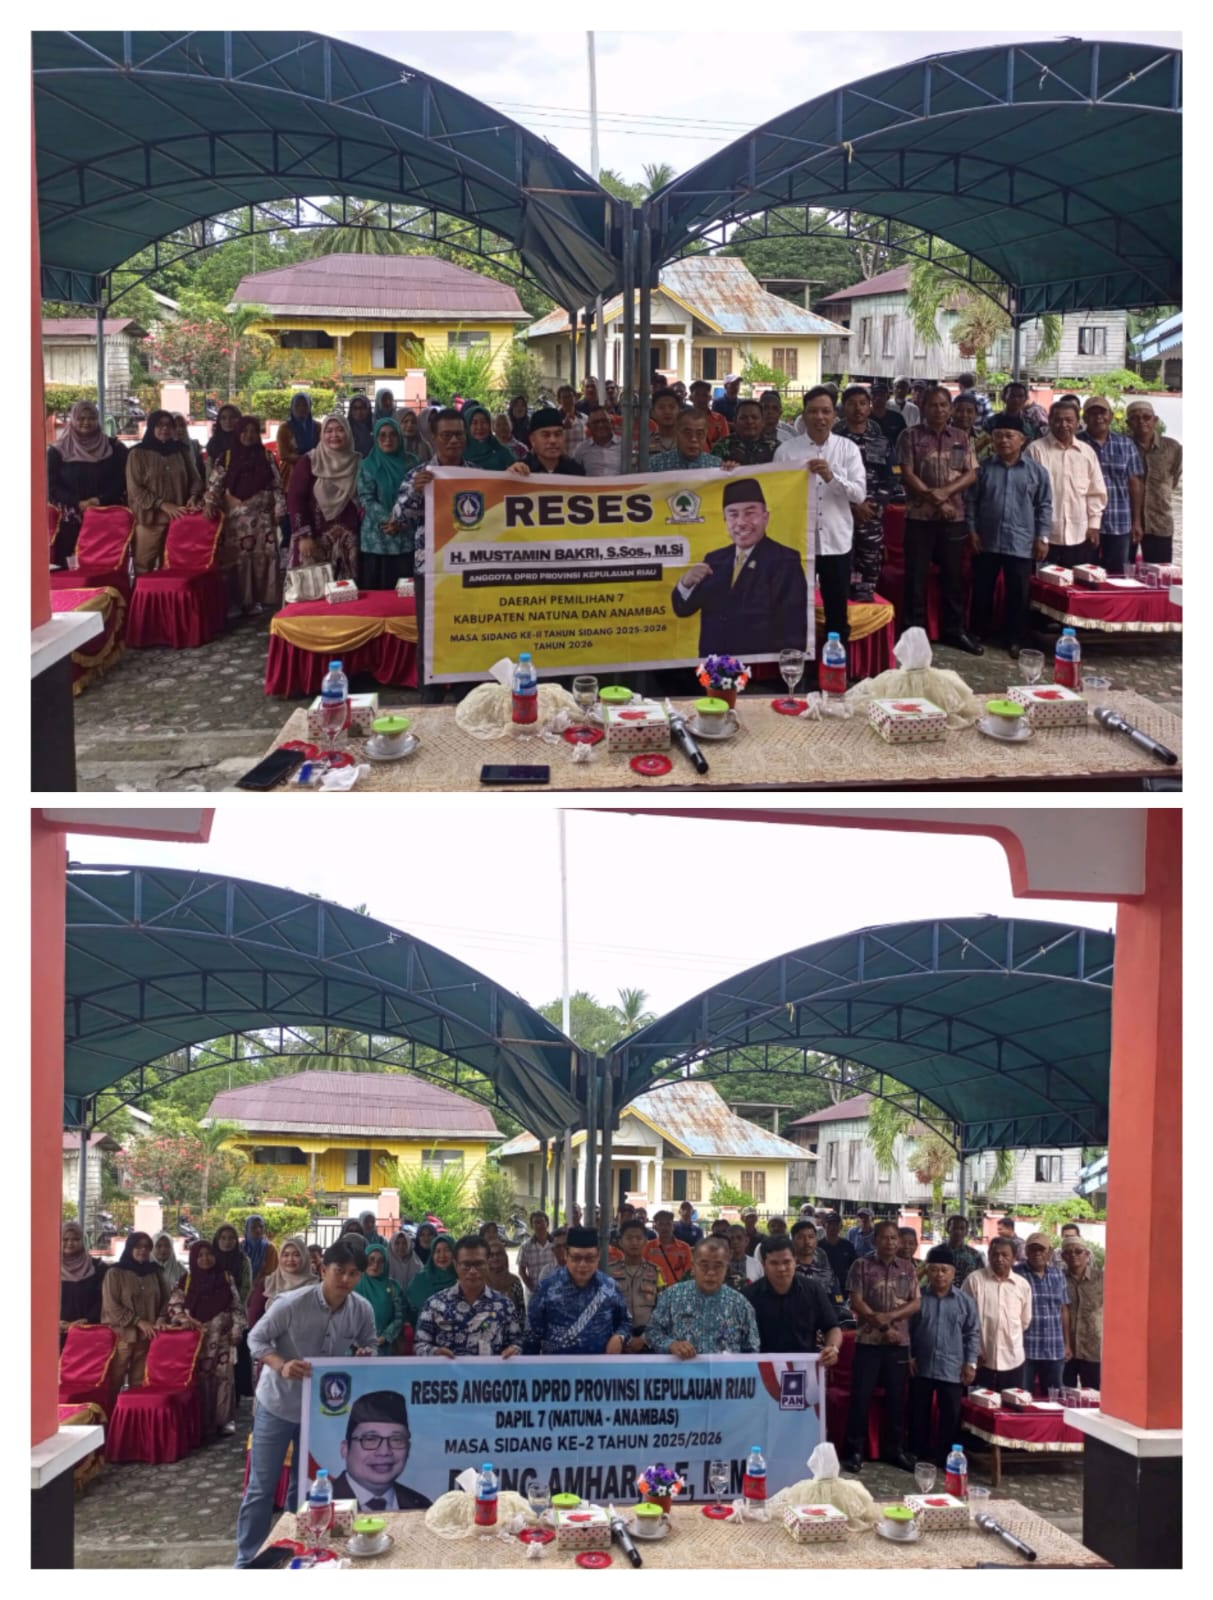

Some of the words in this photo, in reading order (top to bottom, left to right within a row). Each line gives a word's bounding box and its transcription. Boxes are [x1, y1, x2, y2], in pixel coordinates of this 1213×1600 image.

[505, 494, 653, 528] RESES
[450, 551, 466, 564] H.
[470, 549, 551, 562] MUSTAMIN
[555, 547, 603, 560] BAKRI,
[655, 544, 683, 557] M.Si
[469, 573, 512, 582] ANGGOTA
[514, 572, 538, 581] DPRD
[539, 571, 580, 580] PROVINSI
[582, 569, 635, 579] KEPULAUAN
[636, 568, 657, 577] RIAU
[499, 595, 546, 607] DAERAH
[550, 594, 614, 605] PEMILIHAN
[617, 593, 624, 602] 7
[453, 612, 525, 624] KABUPATEN
[528, 610, 578, 621] NATUNA
[581, 609, 607, 619] DAN
[610, 606, 666, 618] ANAMBAS
[450, 633, 478, 642] MASA
[481, 631, 518, 641] SIDANG
[544, 628, 576, 638] TAHUN
[578, 627, 614, 637] SIDANG
[616, 624, 667, 635] 2025-2026
[534, 641, 566, 650] TAHUN
[569, 640, 593, 649] 2026
[411, 1380, 459, 1405] RESES
[461, 1379, 528, 1404] ANGGOTA
[531, 1379, 571, 1403] DPRD
[574, 1378, 640, 1402] PROVINSI
[643, 1377, 723, 1401] KEPULAUAN
[725, 1377, 756, 1400] RIAU
[782, 1396, 803, 1405] PAN
[495, 1410, 534, 1429] DAPIL
[538, 1409, 546, 1428] 7
[548, 1409, 603, 1430] (NATUNA
[612, 1408, 679, 1428] ANAMBAS)
[444, 1439, 490, 1454] MASA
[494, 1437, 552, 1453] SIDANG
[558, 1435, 594, 1451] KE-2
[598, 1434, 648, 1449] TAHUN
[652, 1431, 723, 1449] 2025/2026
